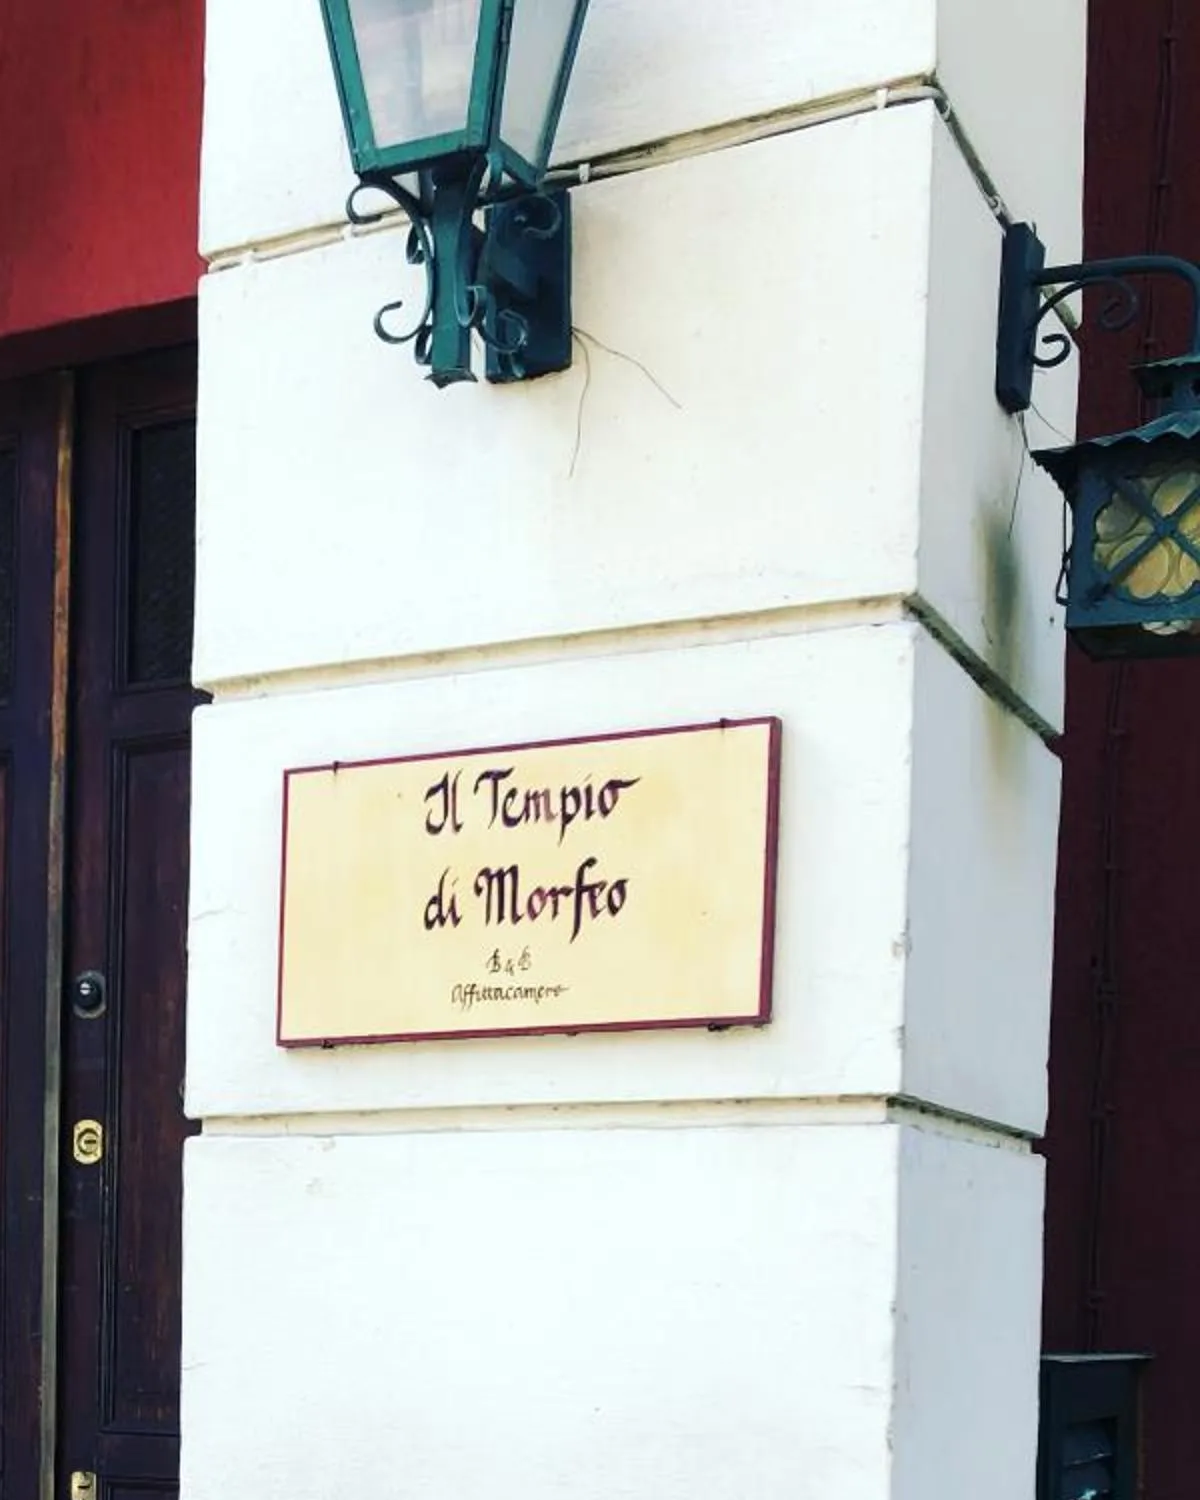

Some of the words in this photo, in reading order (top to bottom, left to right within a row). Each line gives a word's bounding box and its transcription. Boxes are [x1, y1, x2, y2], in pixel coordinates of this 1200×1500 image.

[424, 769, 464, 835] Il
[473, 766, 641, 846] Tempio
[423, 867, 462, 931] di
[473, 857, 629, 944] Morfeo
